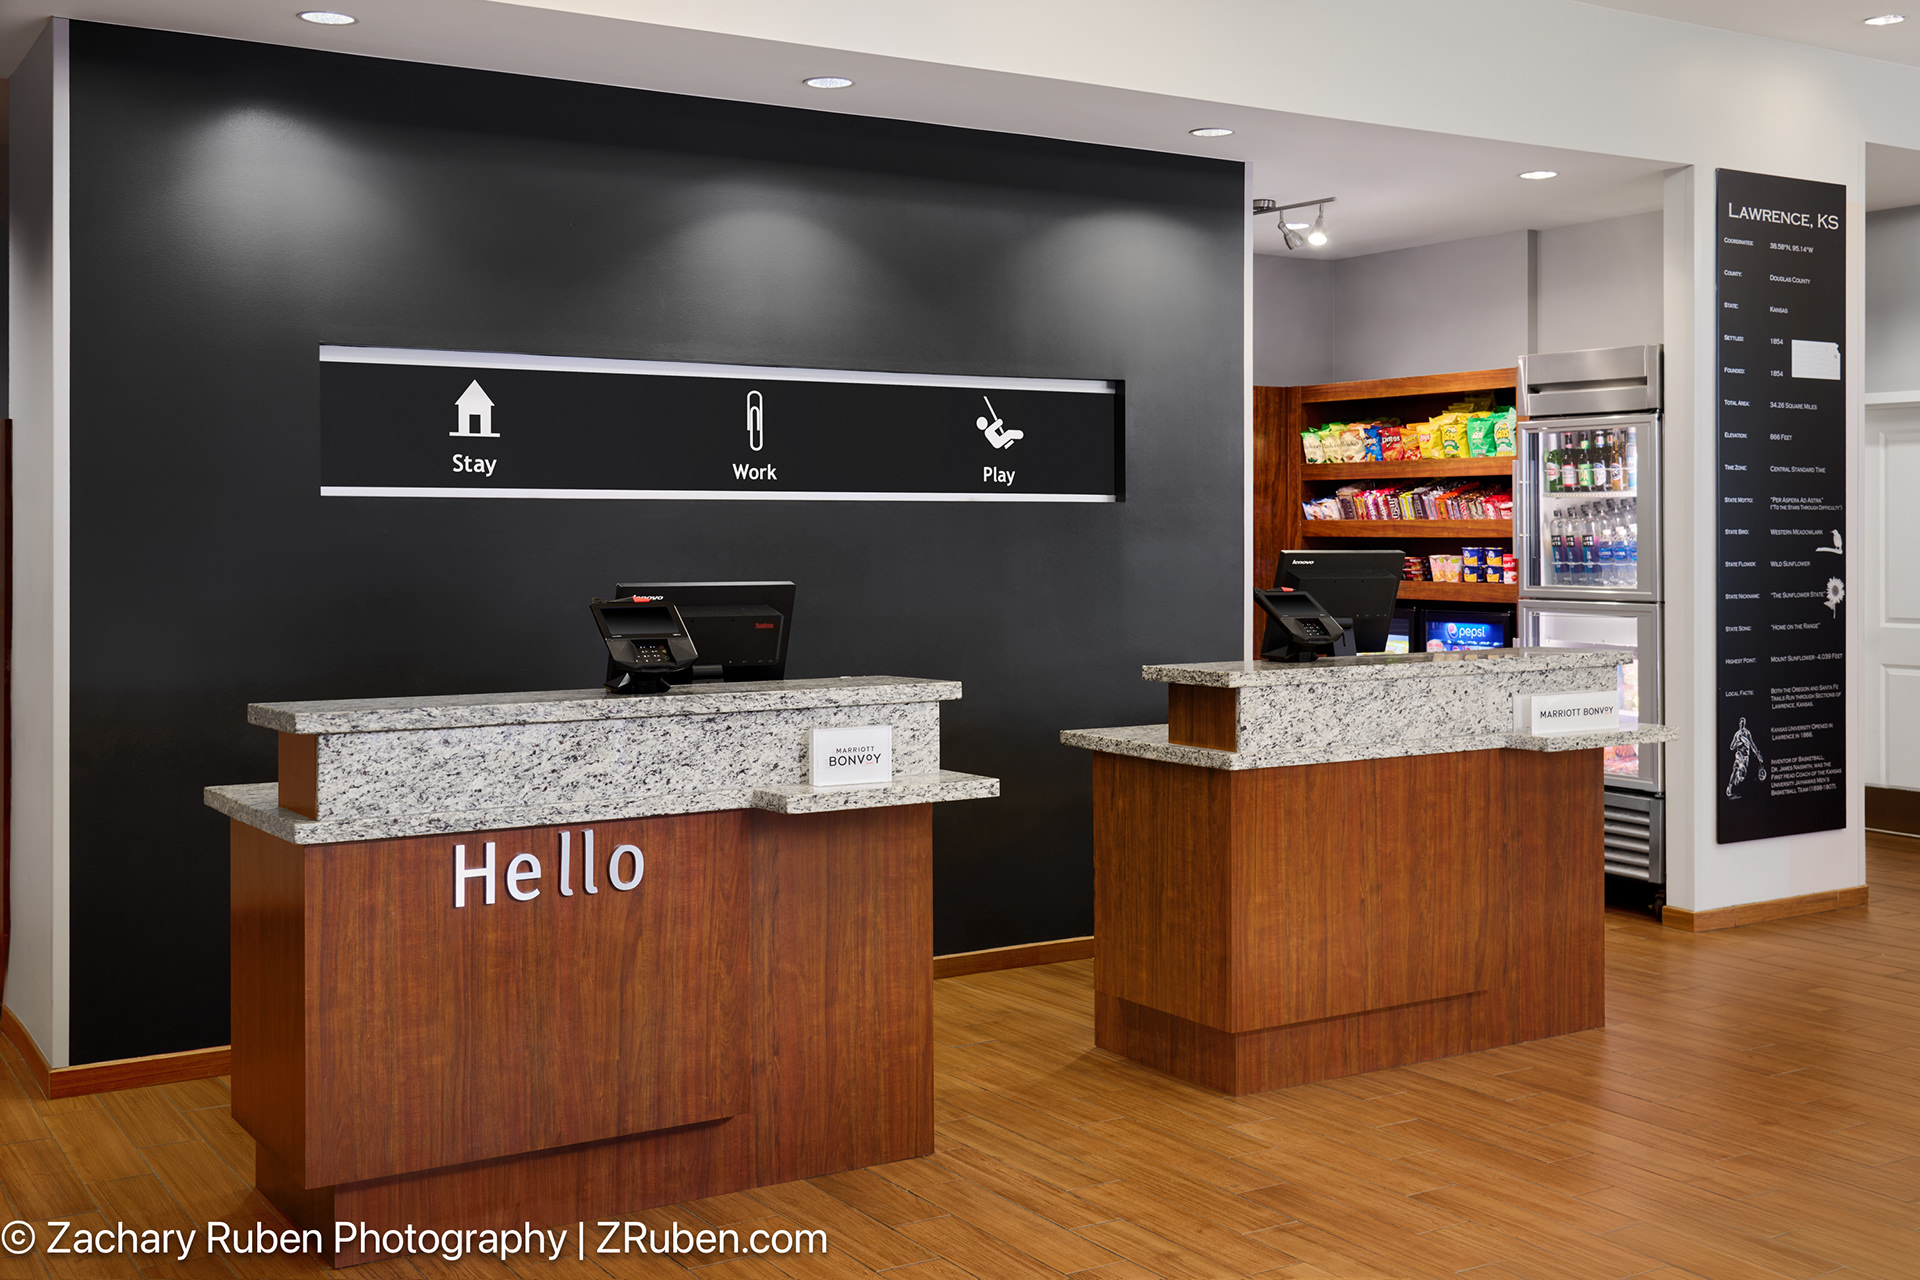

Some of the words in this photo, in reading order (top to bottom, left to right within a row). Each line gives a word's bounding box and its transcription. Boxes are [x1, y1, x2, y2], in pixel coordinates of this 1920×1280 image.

[1728, 202, 1814, 229] LAWRENCE,
[1817, 213, 1840, 230] KS
[1381, 435, 1401, 444] Doritos
[452, 453, 498, 478] Stay
[732, 463, 778, 481] Work
[982, 465, 1017, 487] Play
[1459, 627, 1486, 639] pepsi
[1539, 708, 1582, 719] MARRIOTT
[1583, 705, 1614, 716] BONVOY
[836, 746, 875, 754] MARRIOTT
[828, 753, 882, 768] BONVOY
[454, 828, 645, 908] Hello
